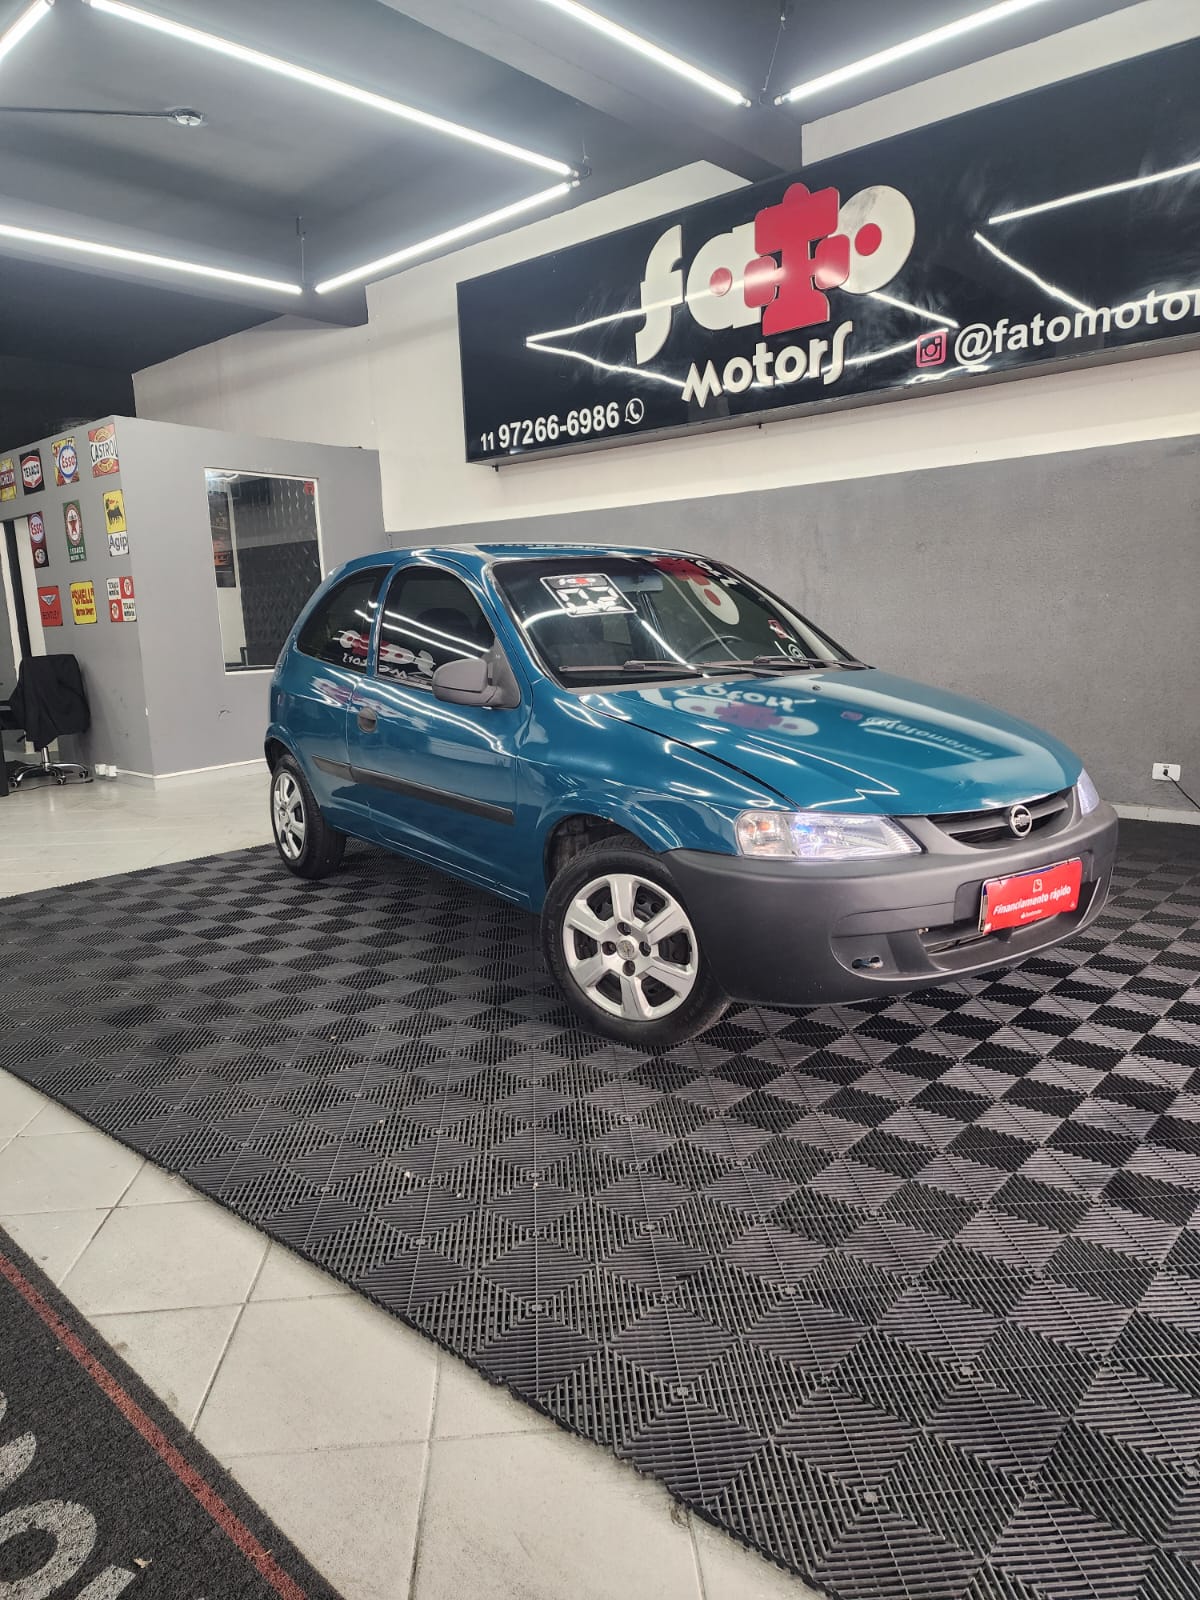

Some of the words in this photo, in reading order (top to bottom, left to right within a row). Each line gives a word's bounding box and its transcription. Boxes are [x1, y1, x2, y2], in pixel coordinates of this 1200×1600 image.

[681, 320, 853, 408] Motors
[480, 431, 495, 451] 11
[498, 401, 620, 449] 97266-6986
[109, 533, 128, 551] Agip
[993, 893, 1049, 916] Financiamento
[1049, 884, 1072, 901] rápido
